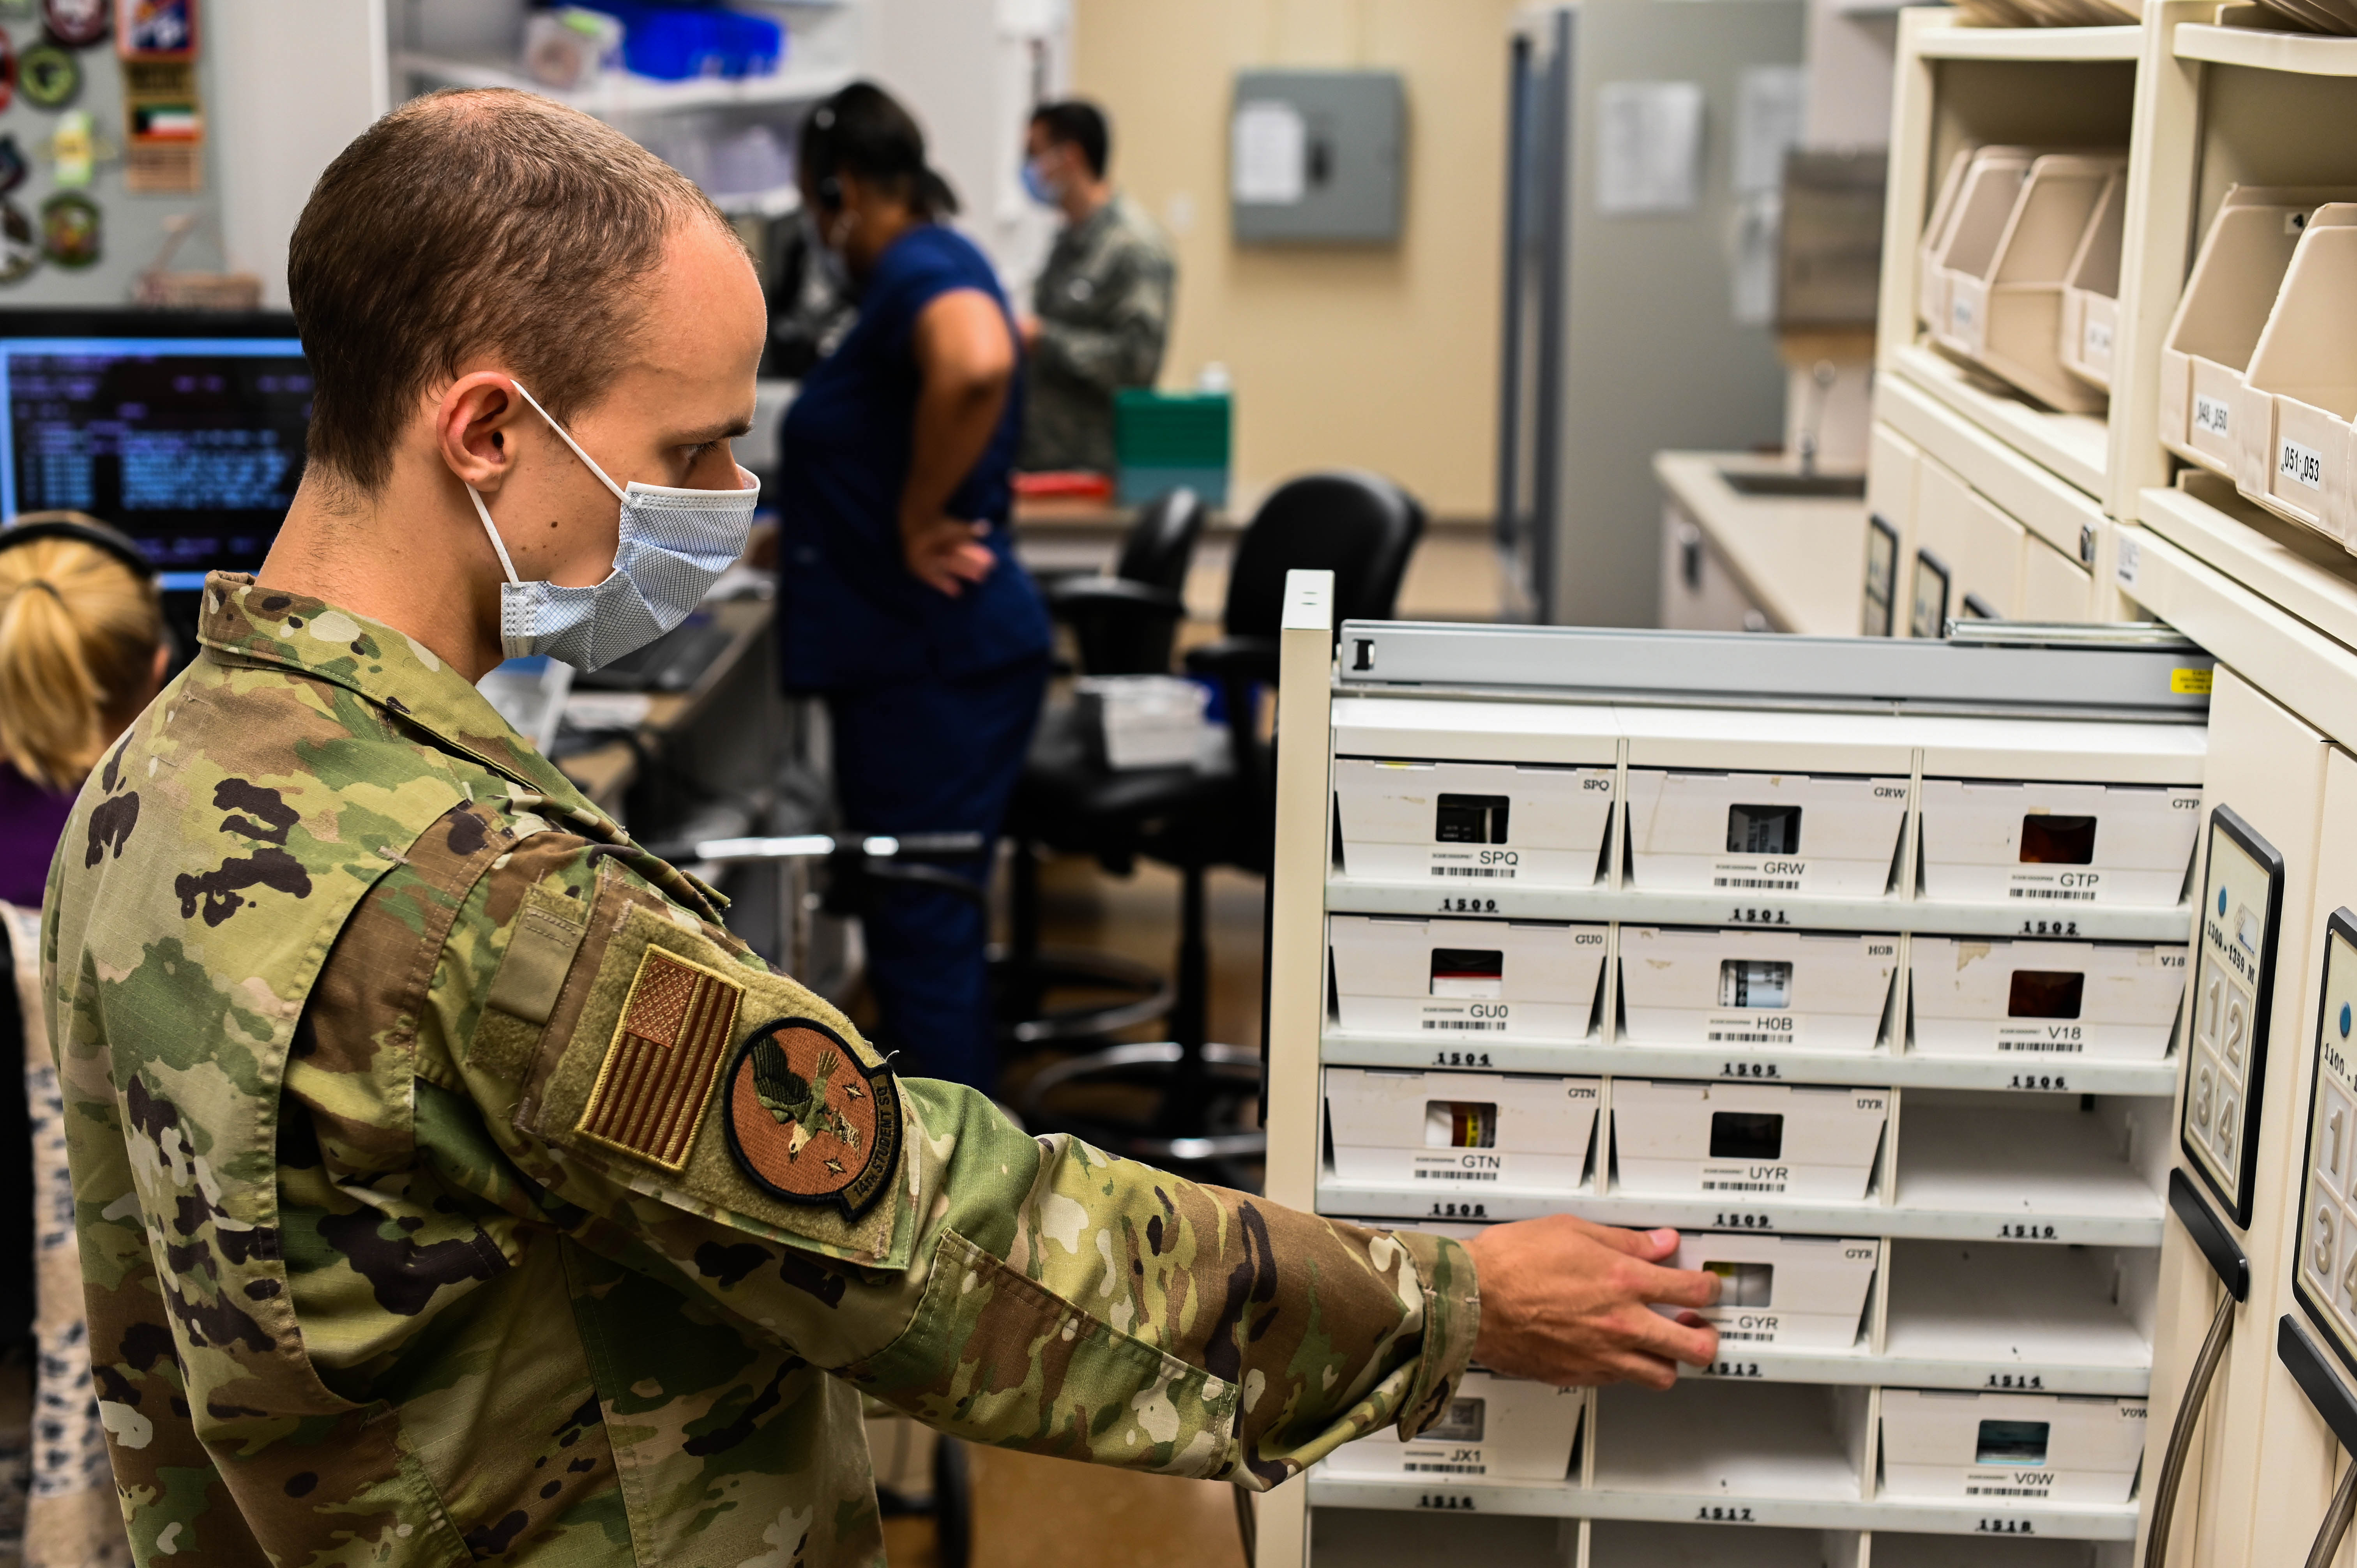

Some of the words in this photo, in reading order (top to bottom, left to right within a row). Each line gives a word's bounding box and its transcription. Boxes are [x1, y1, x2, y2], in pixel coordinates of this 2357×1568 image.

[1583, 779, 1610, 792] SPQ
[1874, 786, 1906, 799] GRW
[2172, 799, 2200, 809] GTP
[1480, 851, 1518, 866] SPQ
[1763, 862, 1805, 874] GRW
[2060, 873, 2099, 887] GTP
[1443, 898, 1496, 910] 1500
[1733, 908, 1786, 921] 1501
[2023, 921, 2077, 933] 1502
[2208, 920, 2222, 948] 1300
[2229, 945, 2244, 973] 1359
[2247, 964, 2255, 985] M
[2048, 1026, 2081, 1040] V18
[2226, 1000, 2242, 1068] 2
[1437, 1052, 1489, 1064] 1504
[2325, 1043, 2344, 1076] 1100
[1724, 1063, 1777, 1076] 1505
[2011, 1075, 2065, 1088] 1506
[1568, 1088, 1595, 1098] GTN
[1857, 1099, 1882, 1110] UYR
[2198, 1066, 2212, 1127] 3
[2219, 1095, 2233, 1158] 4
[873, 1110, 892, 1173] STUDENT
[1462, 1155, 1500, 1168] GTN
[1749, 1167, 1788, 1180] UYR
[2315, 1205, 2333, 1275] 3
[1846, 1249, 1873, 1259] GYR
[1739, 1316, 1778, 1330] GYR
[1450, 1449, 1481, 1462] JX1
